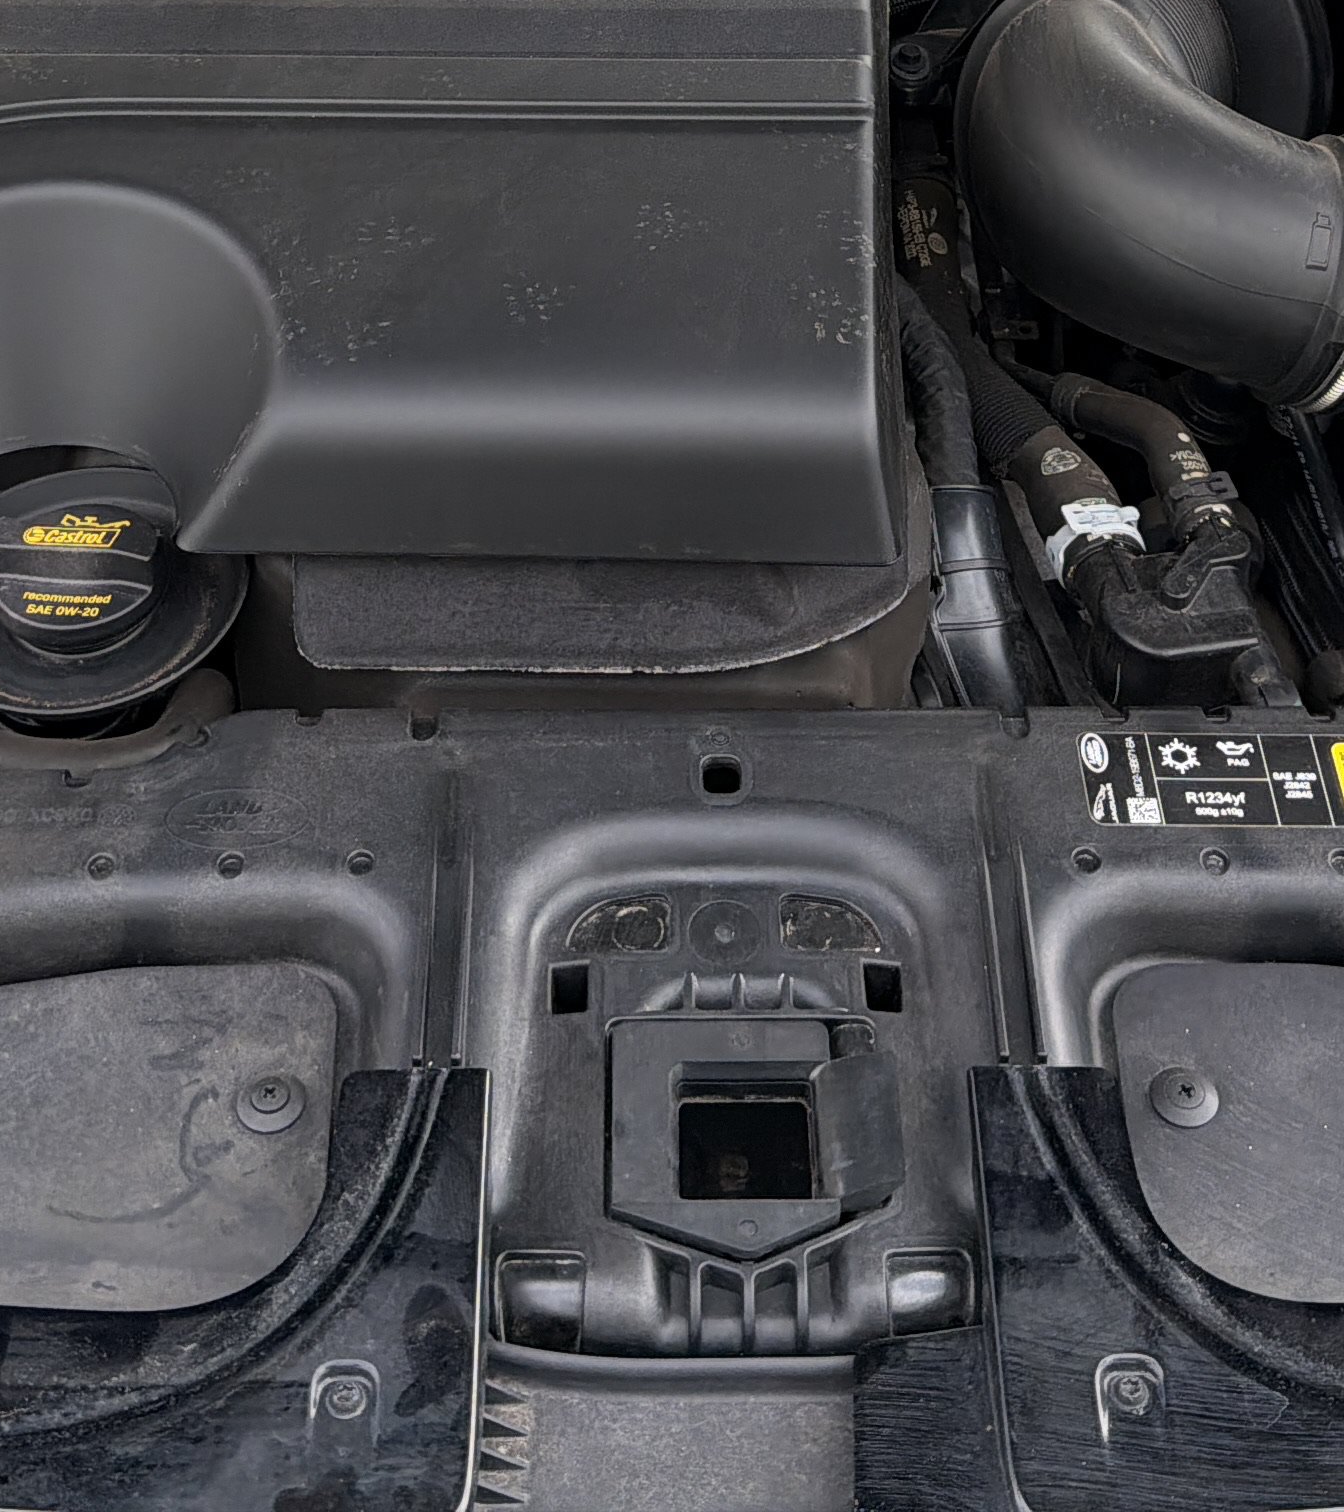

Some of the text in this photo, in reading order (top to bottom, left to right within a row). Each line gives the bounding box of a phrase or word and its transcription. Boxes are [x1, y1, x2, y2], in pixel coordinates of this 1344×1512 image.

[43, 529, 107, 546] Castrol
[23, 591, 113, 605] recommended
[26, 604, 99, 618] SAE 0W-20
[1226, 757, 1250, 767] PAG
[1184, 791, 1246, 807] R1234yf
